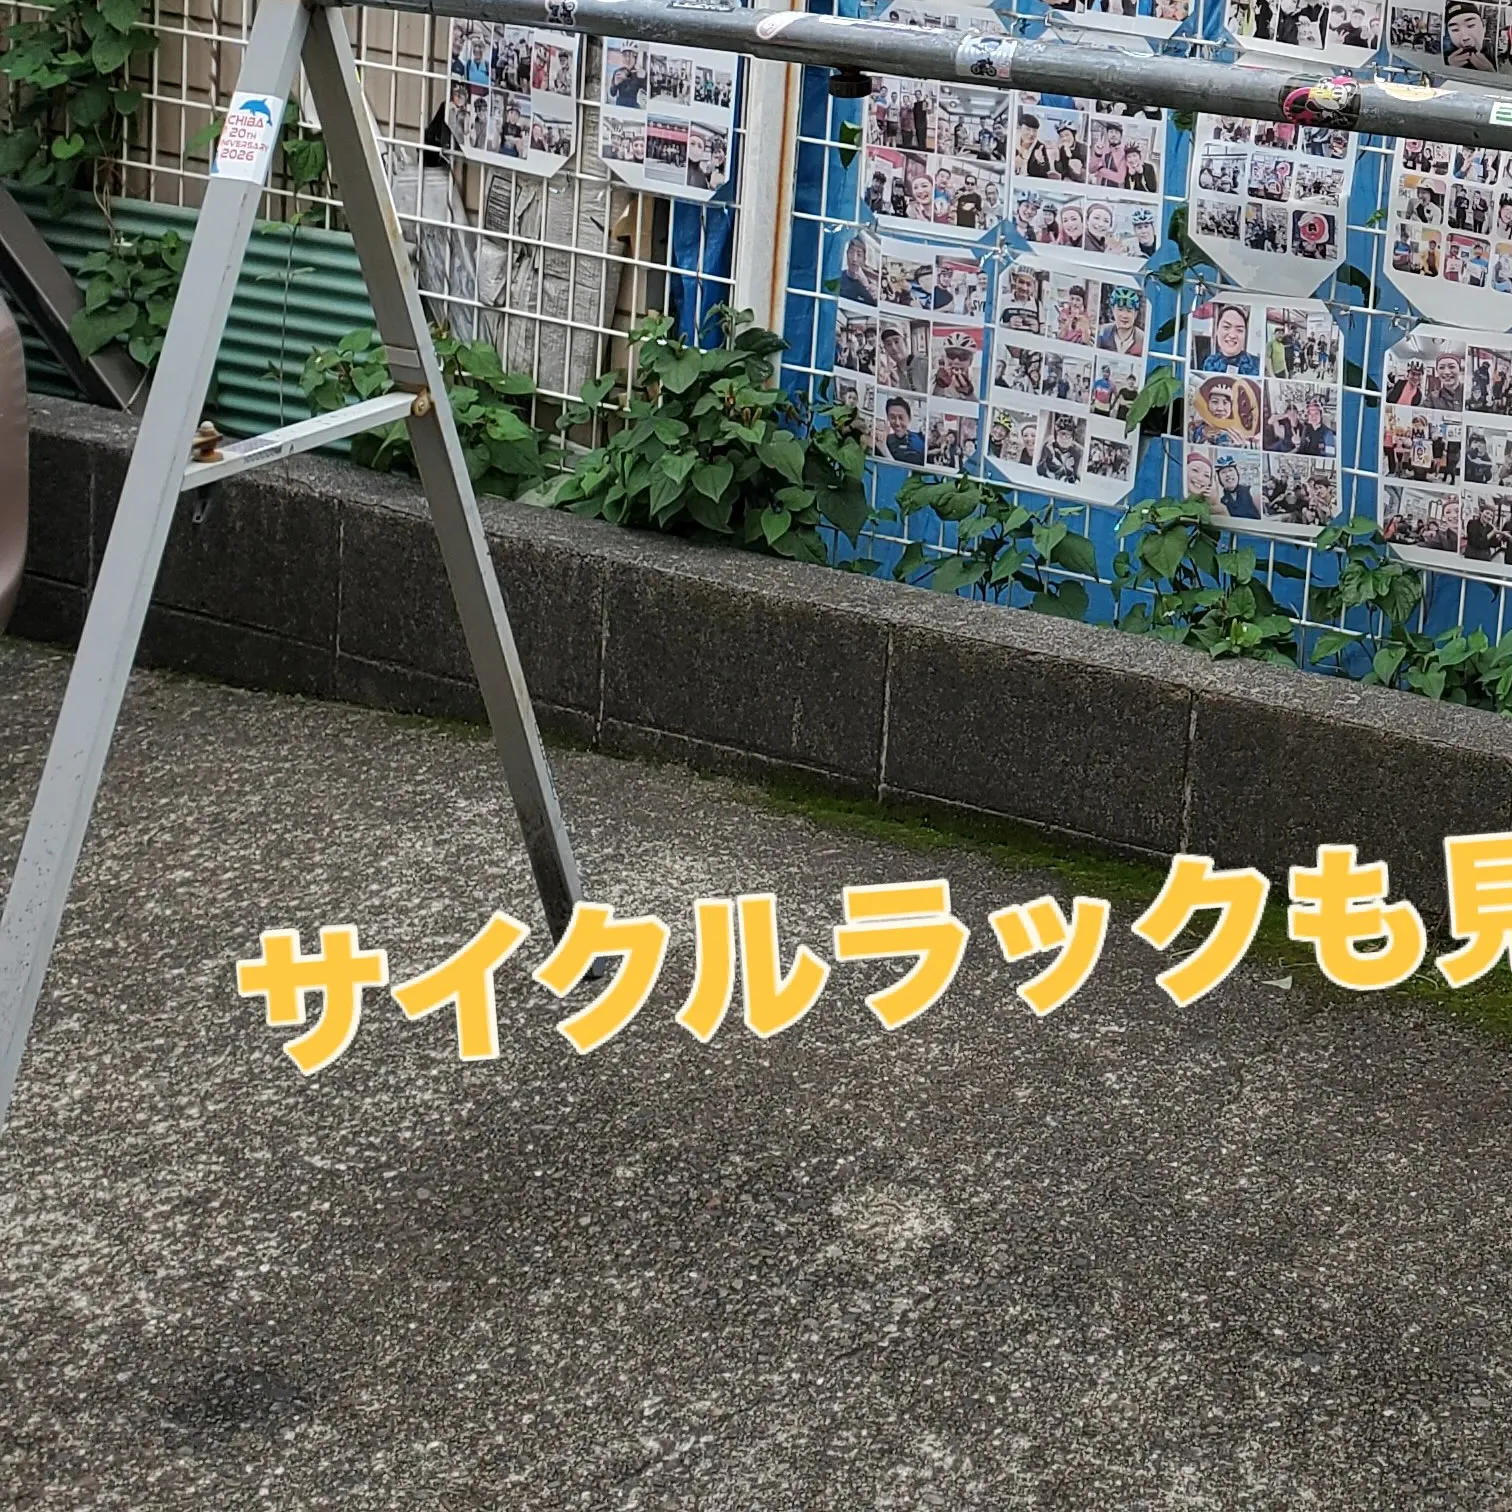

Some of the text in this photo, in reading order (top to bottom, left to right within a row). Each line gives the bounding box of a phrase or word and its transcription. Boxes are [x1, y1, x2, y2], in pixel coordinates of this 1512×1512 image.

[228, 114, 264, 128] CHIBA
[229, 128, 257, 139] 20TH
[220, 148, 255, 161] 2026
